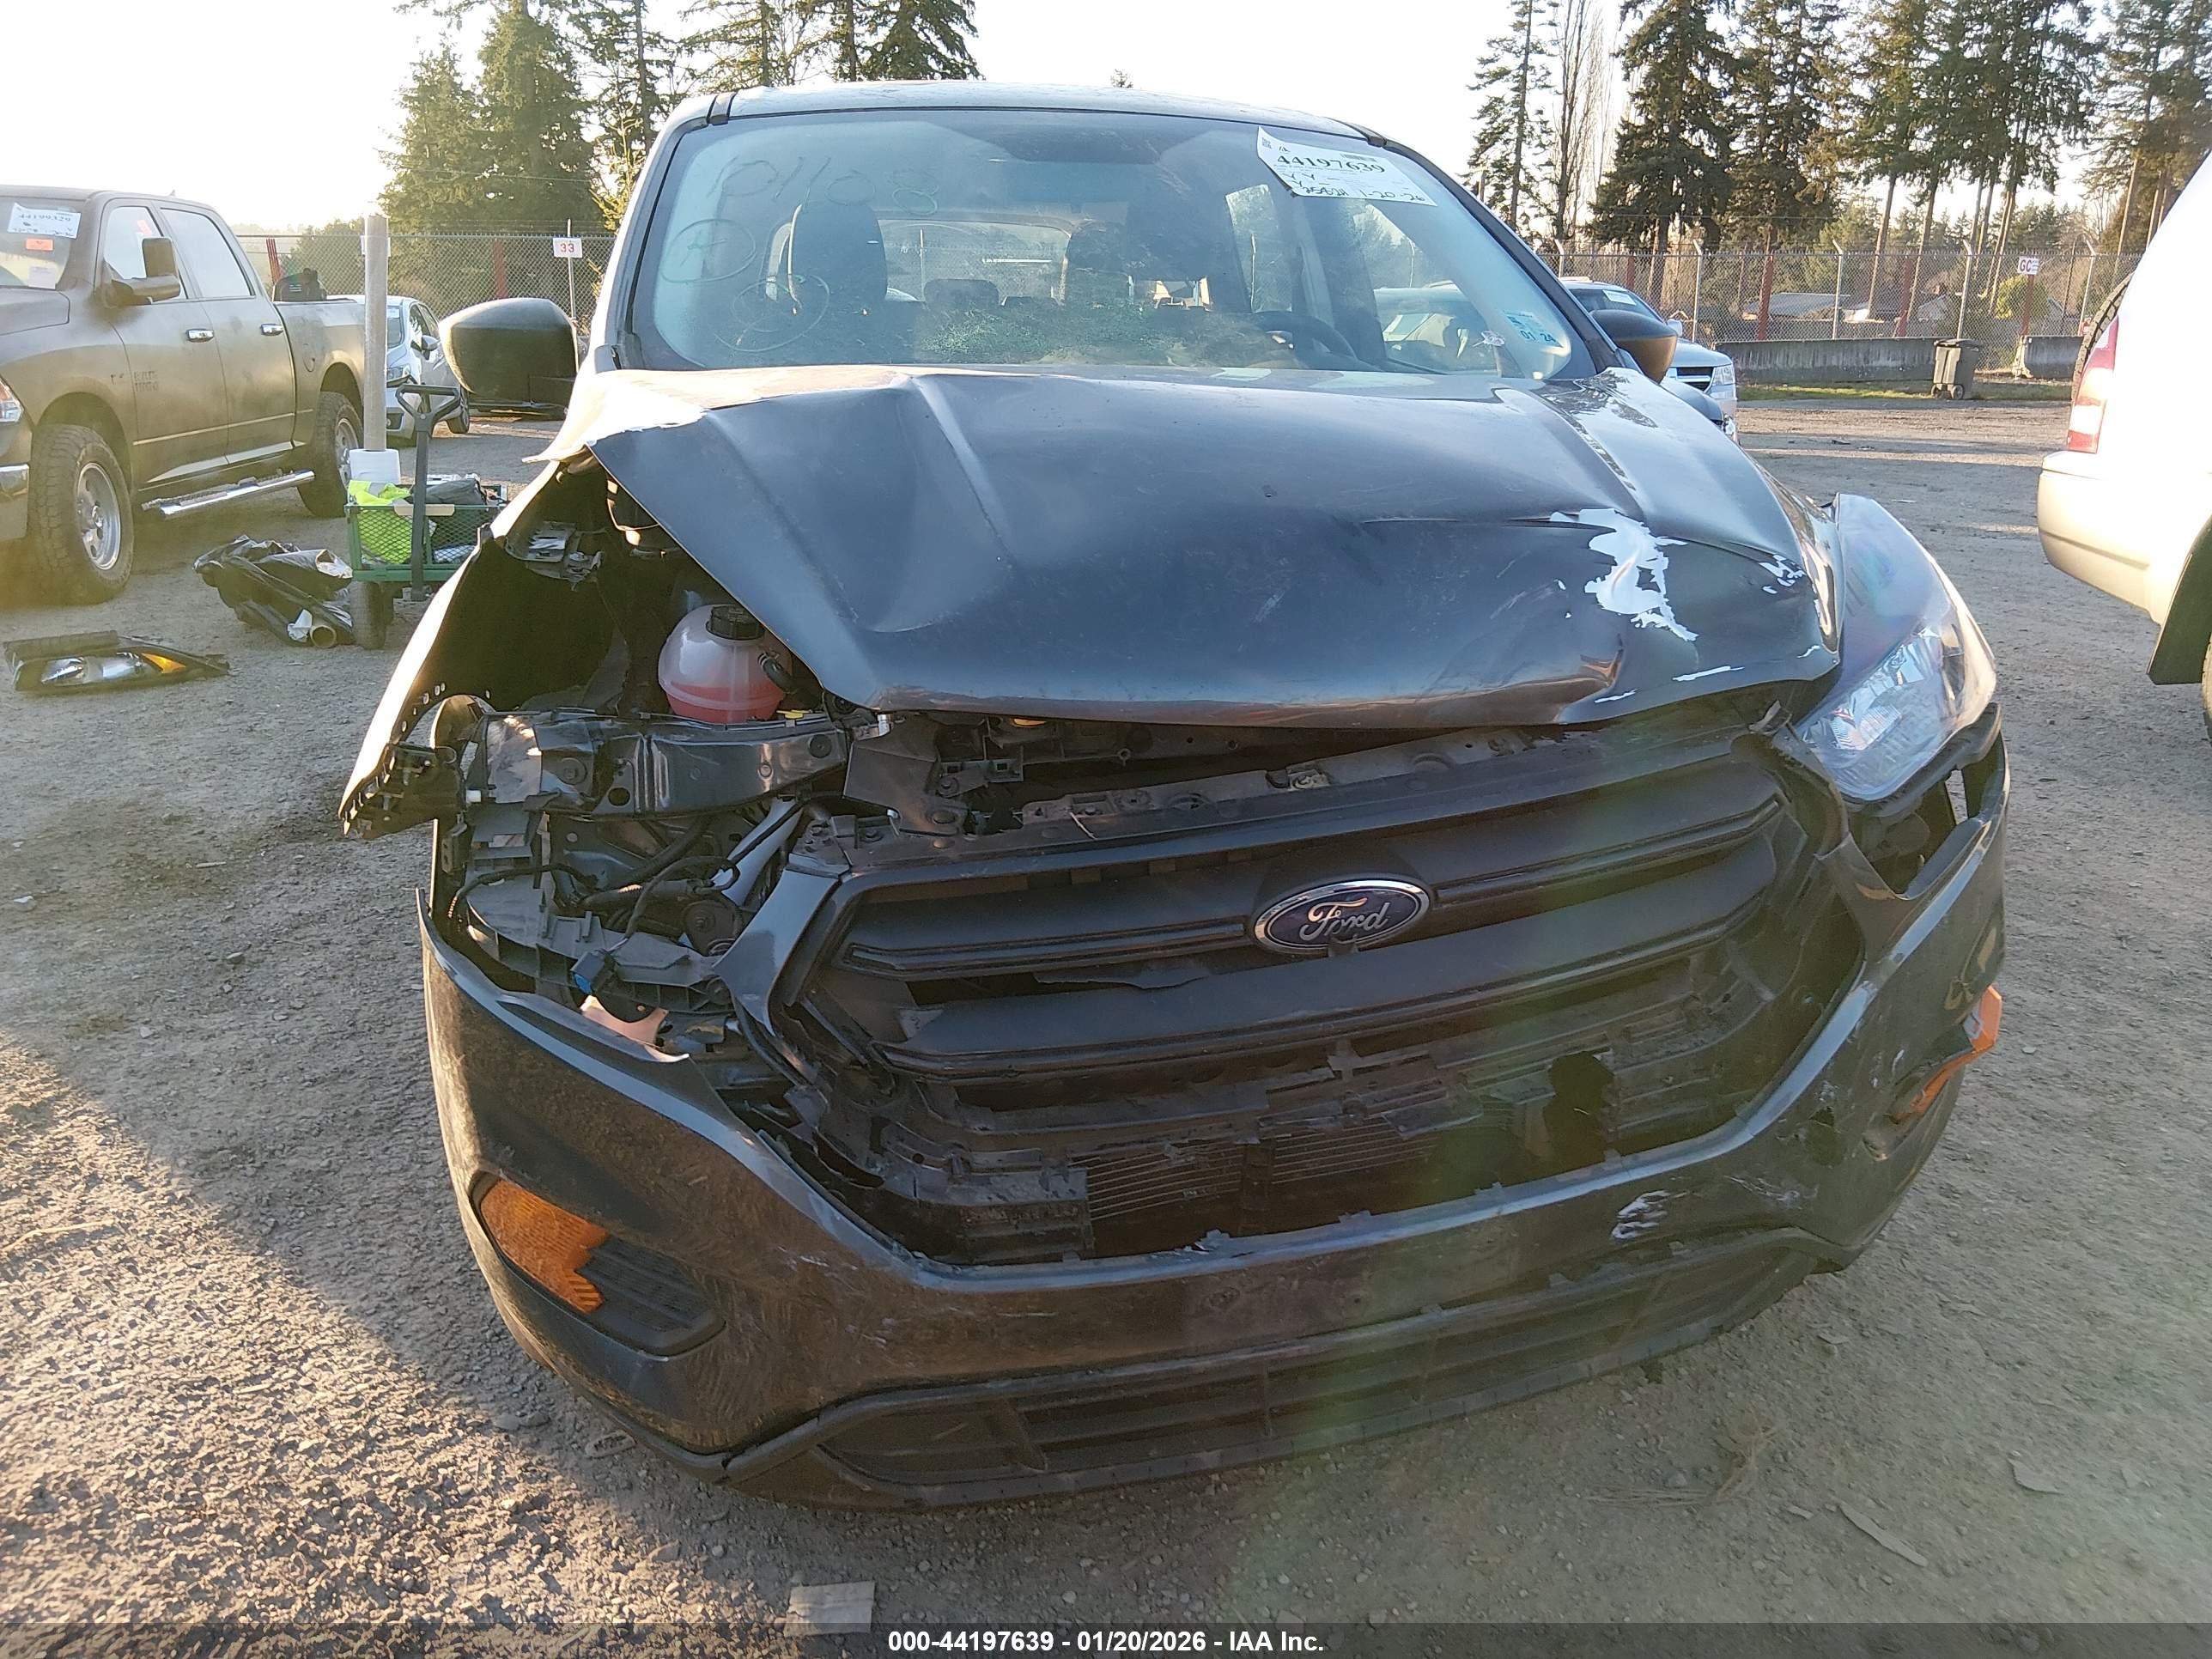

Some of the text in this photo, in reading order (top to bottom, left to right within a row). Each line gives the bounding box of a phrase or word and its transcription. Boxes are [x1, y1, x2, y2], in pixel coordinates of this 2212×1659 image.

[1277, 155, 1386, 173] 44197639
[560, 243, 574, 253] 33
[1299, 897, 1390, 941] Ford
